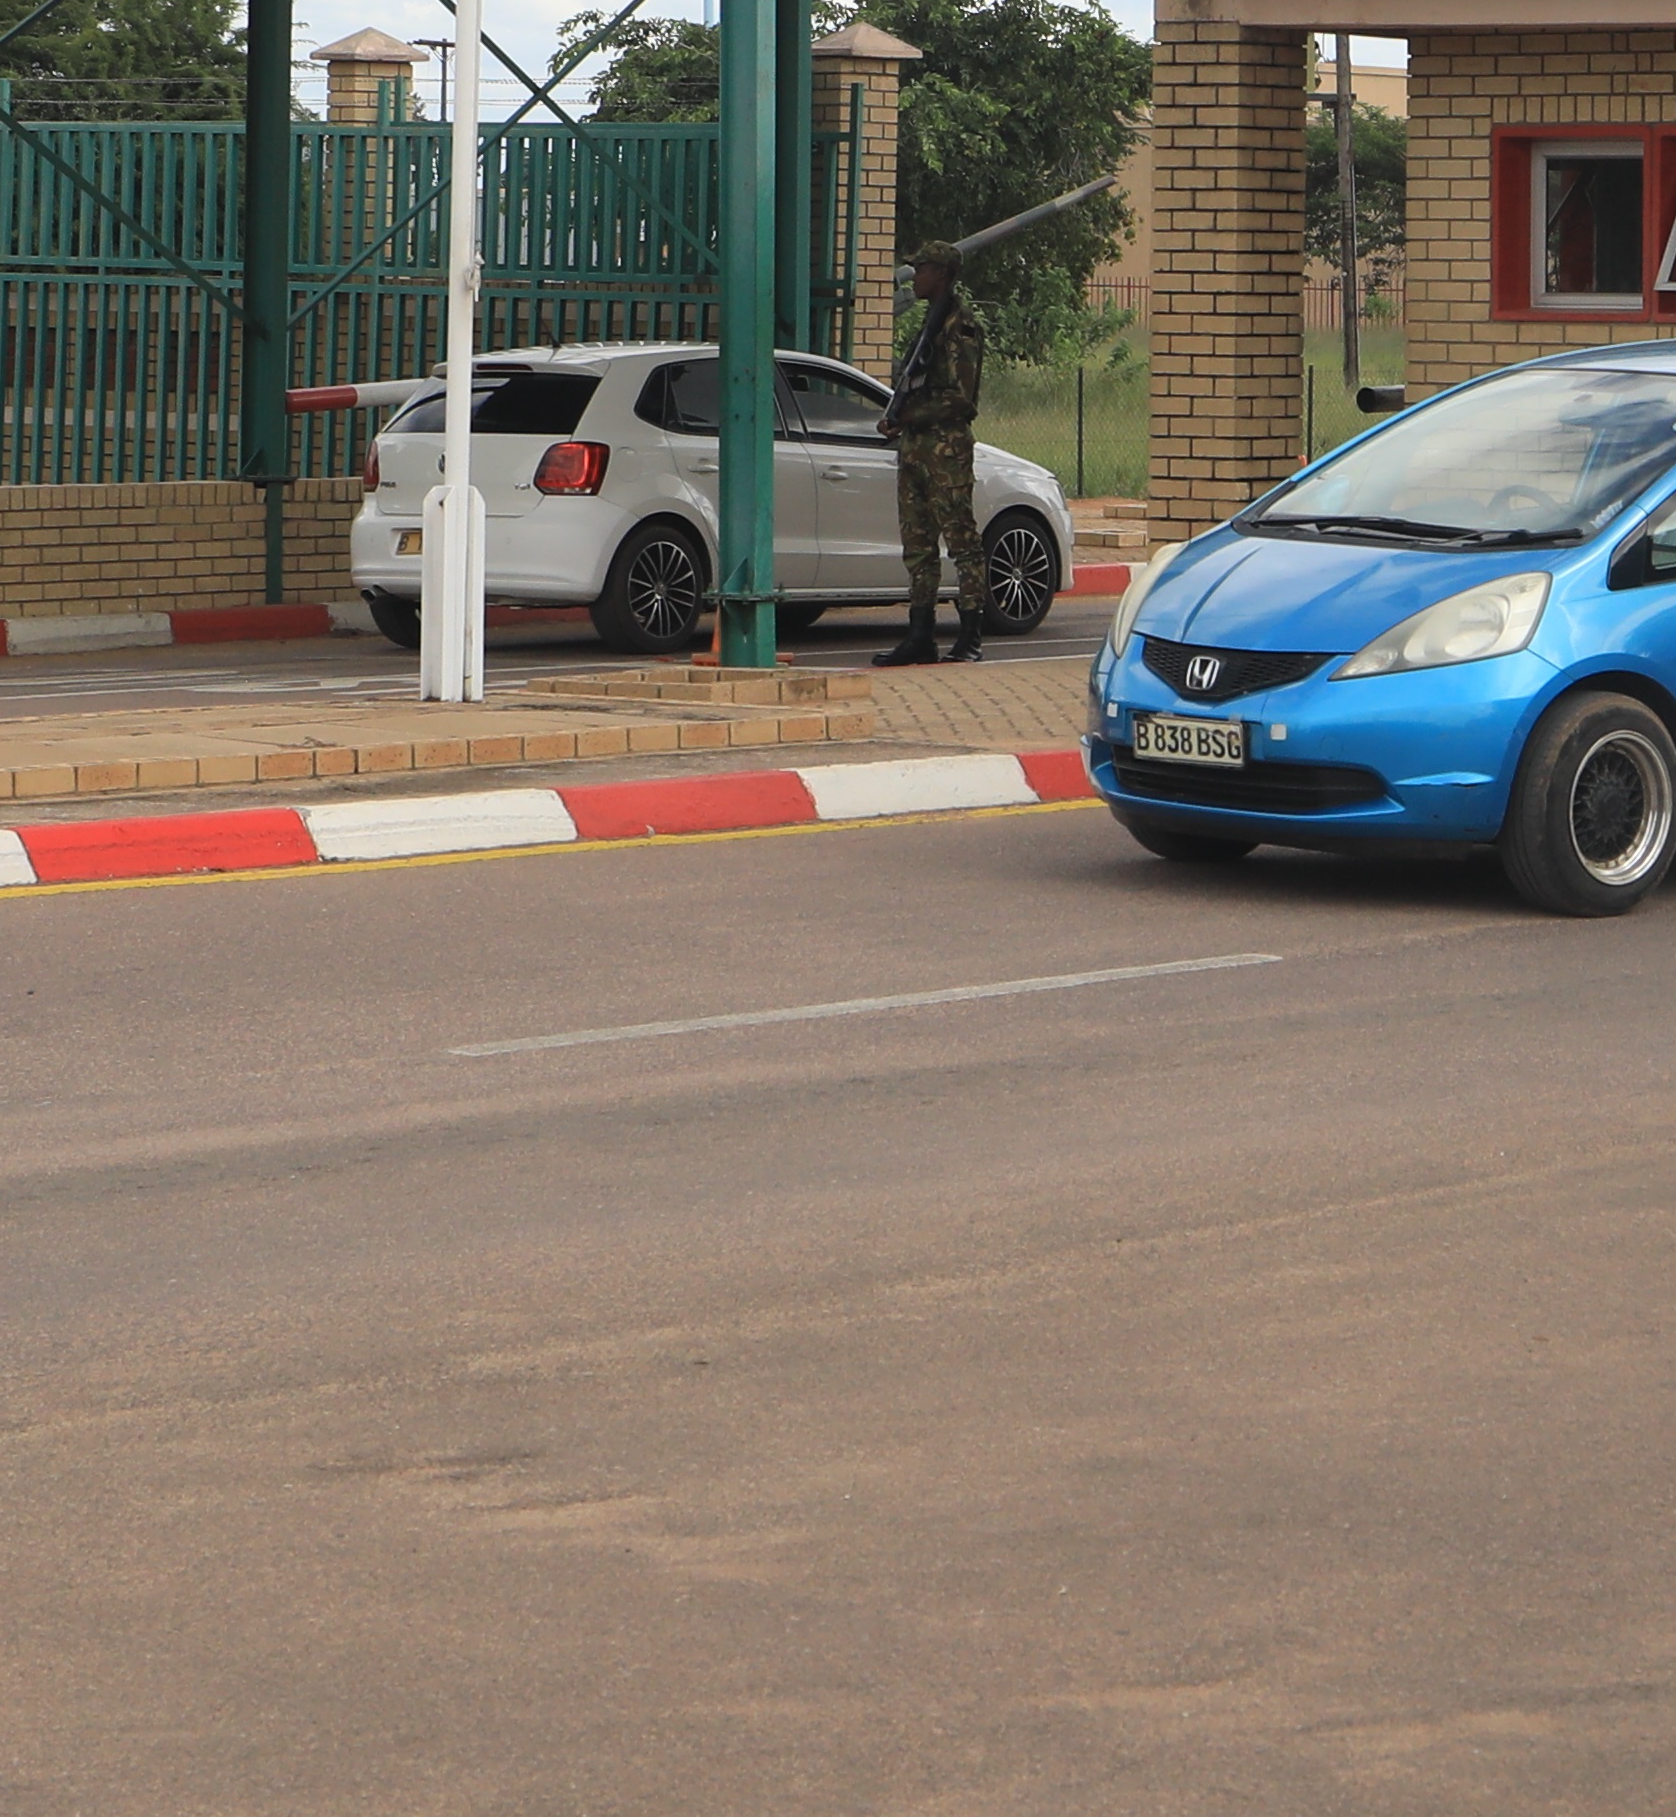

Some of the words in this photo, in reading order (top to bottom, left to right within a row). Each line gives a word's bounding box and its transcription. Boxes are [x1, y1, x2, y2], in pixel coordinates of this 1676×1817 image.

[397, 535, 409, 551] B
[1137, 723, 1149, 751] B
[1154, 725, 1192, 754] 838
[1197, 728, 1241, 759] BSG
